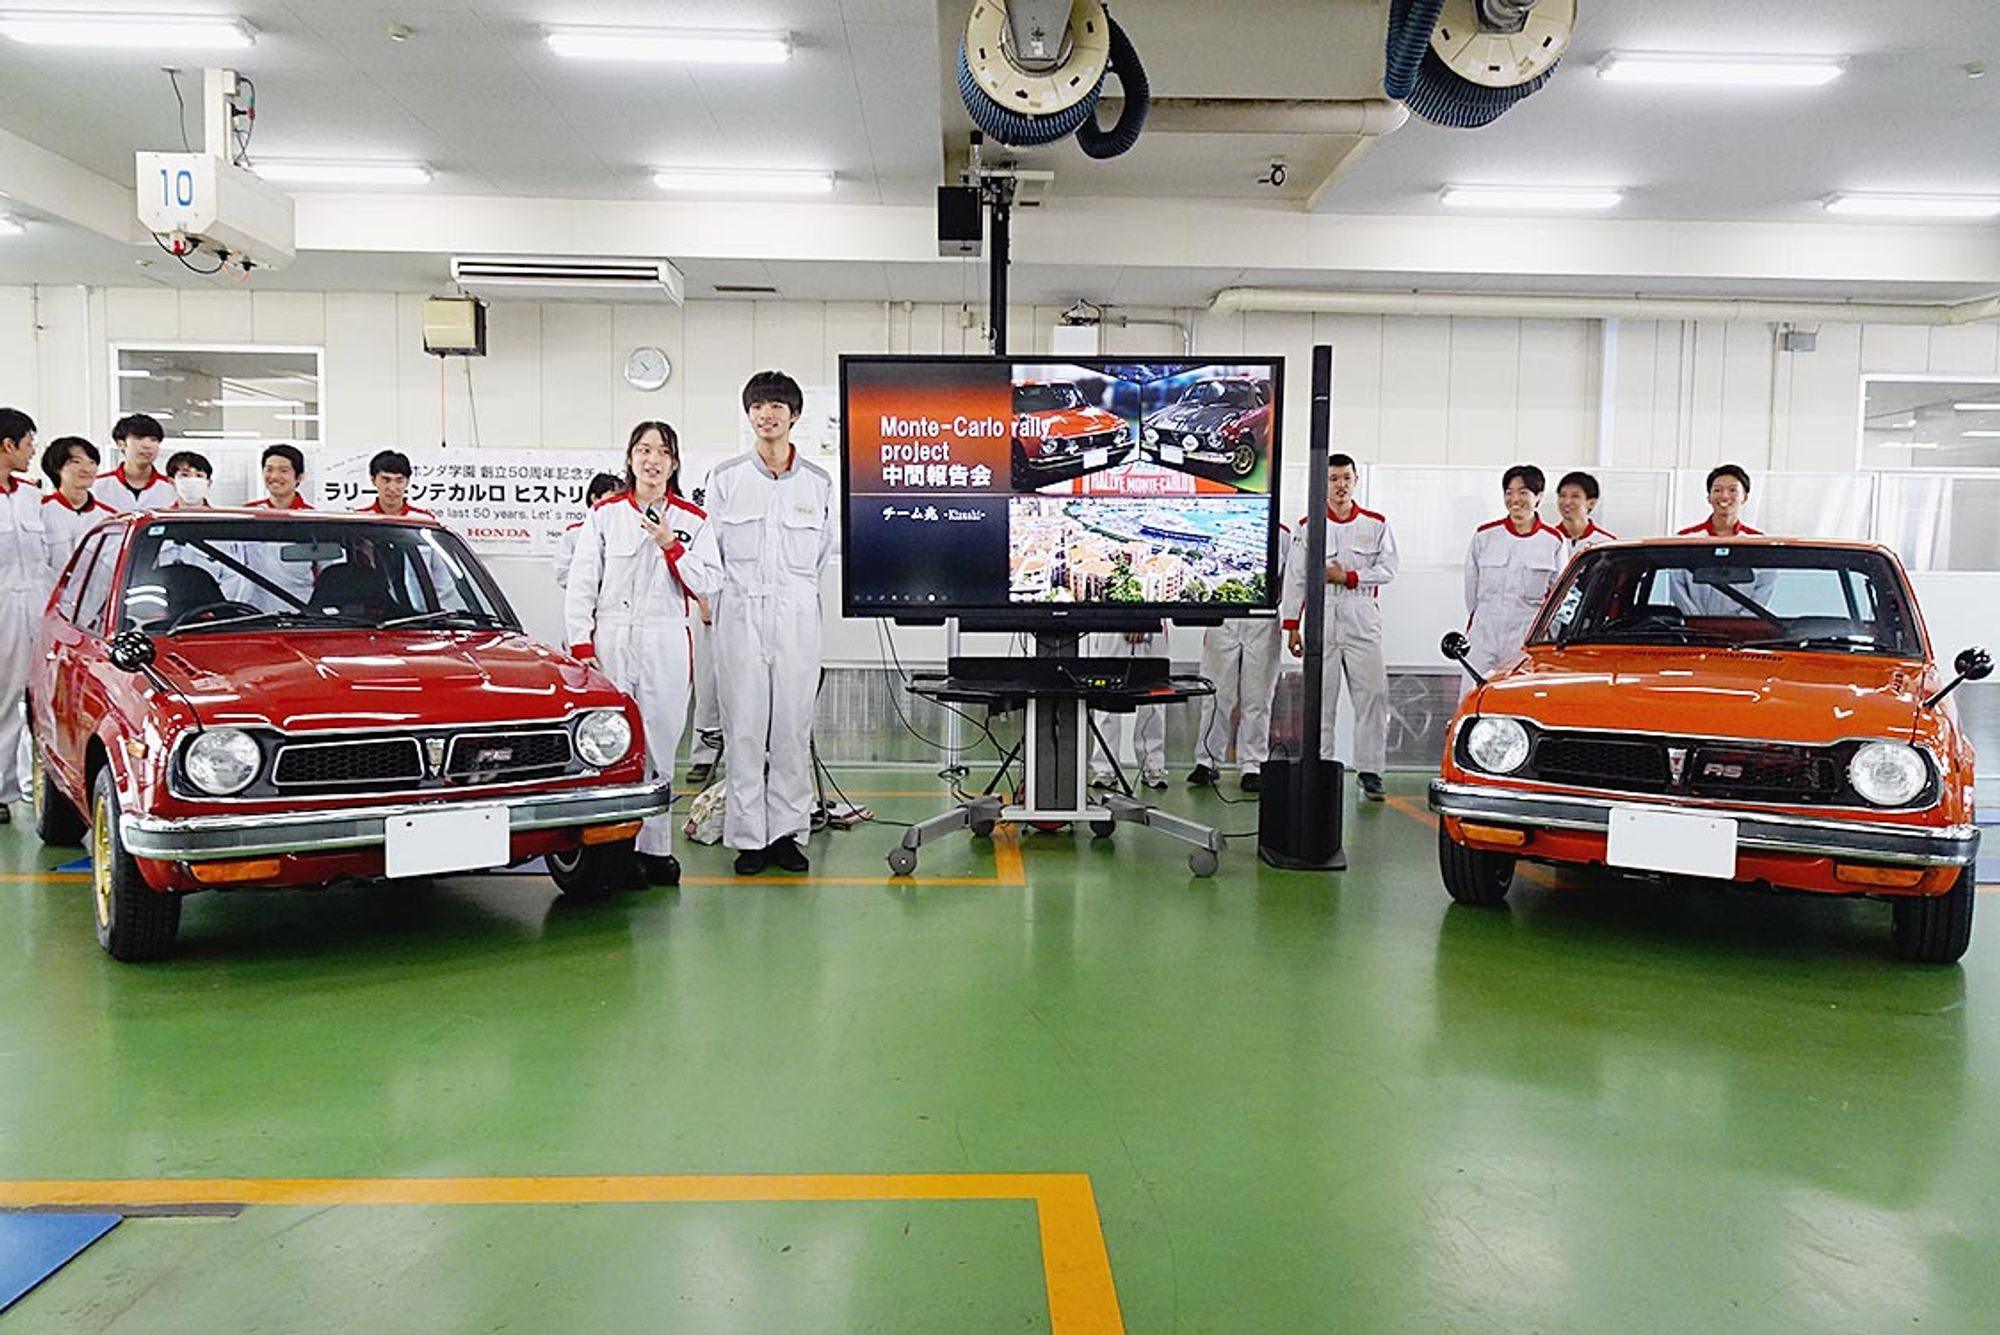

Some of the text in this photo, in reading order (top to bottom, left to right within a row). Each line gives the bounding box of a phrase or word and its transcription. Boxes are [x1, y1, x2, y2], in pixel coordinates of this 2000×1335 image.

[160, 168, 193, 207] 10
[880, 415, 1050, 440] Monte-Carlo rally
[880, 441, 950, 463] project
[882, 464, 993, 487] 中間報告会
[446, 507, 470, 519] last
[473, 507, 491, 519] 50
[467, 528, 531, 538] HONDA
[1703, 763, 1743, 779] RS
